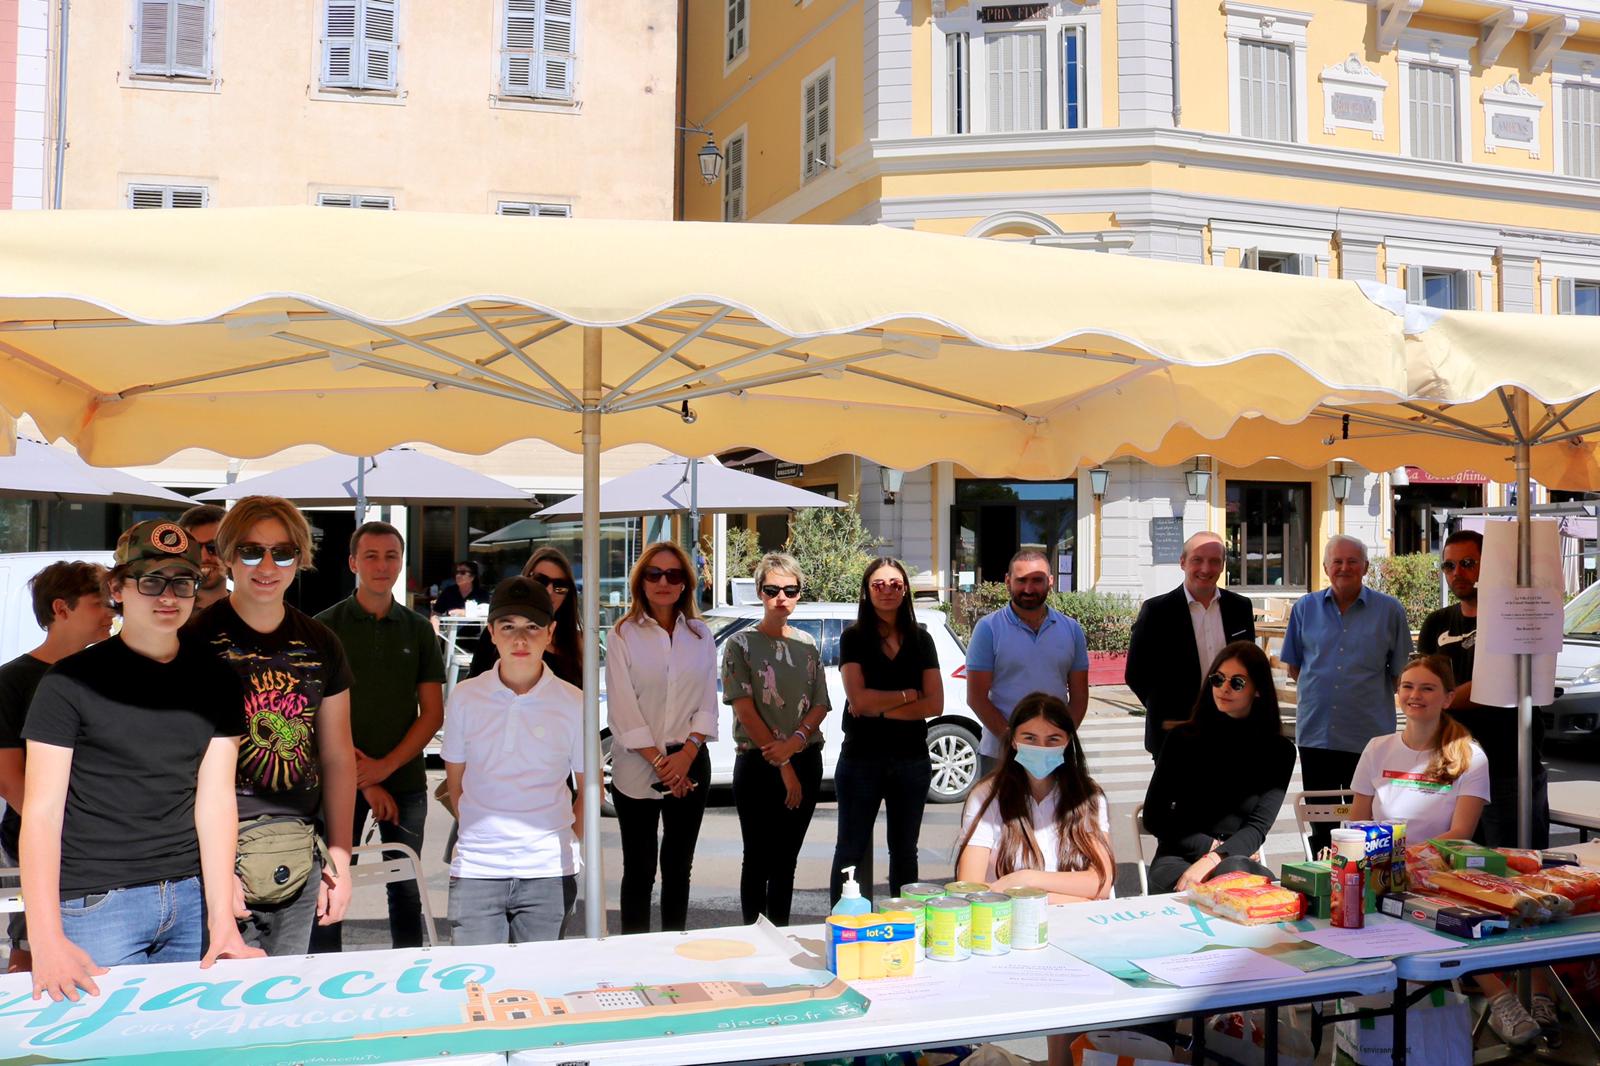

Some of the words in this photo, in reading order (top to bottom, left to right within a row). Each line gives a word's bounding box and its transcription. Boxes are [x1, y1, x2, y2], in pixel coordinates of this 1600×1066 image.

[986, 8, 1012, 21] PRIX
[1365, 836, 1391, 853] RINCE
[1087, 909, 1155, 926] Ville
[718, 1010, 821, 1029] ajaccio.fr
